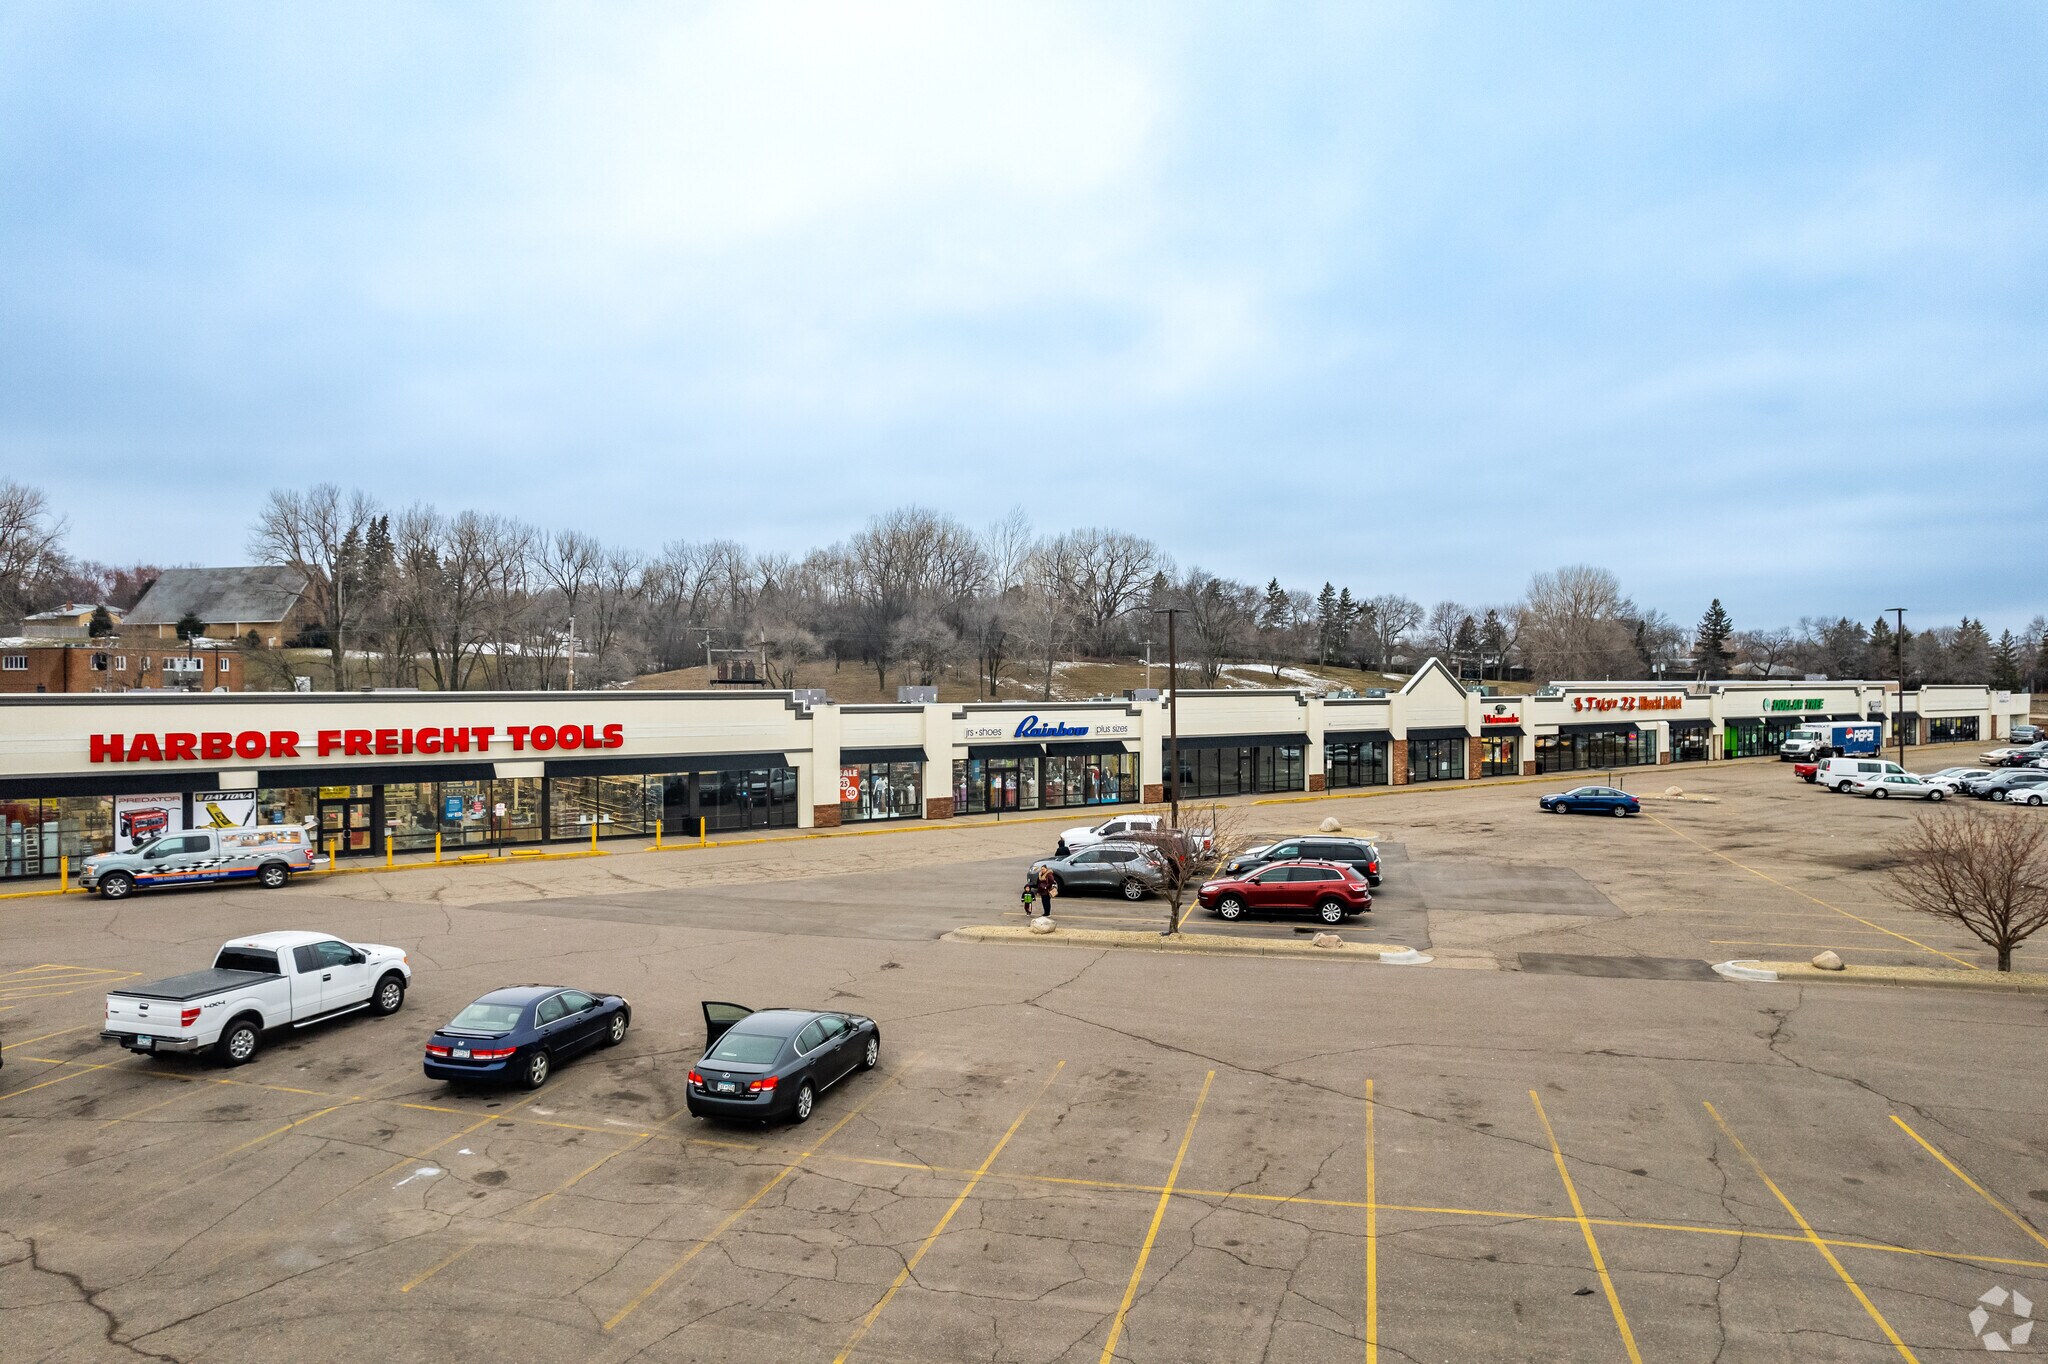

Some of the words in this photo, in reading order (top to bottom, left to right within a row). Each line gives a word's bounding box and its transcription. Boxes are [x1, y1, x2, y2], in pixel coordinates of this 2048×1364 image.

[1772, 699, 1804, 711] DOLLAR
[1805, 699, 1824, 710] TREE
[1014, 715, 1089, 738] Rainbow
[1096, 725, 1111, 733] plus
[1111, 724, 1128, 733] sizes
[979, 727, 1002, 737] shoes
[1853, 729, 1874, 742] PEPSI
[89, 731, 300, 762] HARBOR
[317, 726, 495, 757] FREIGHT
[507, 723, 624, 752] TOOLS
[204, 792, 253, 801] DAYTONA
[847, 789, 856, 797] 50
[118, 795, 180, 804] PREDATOR
